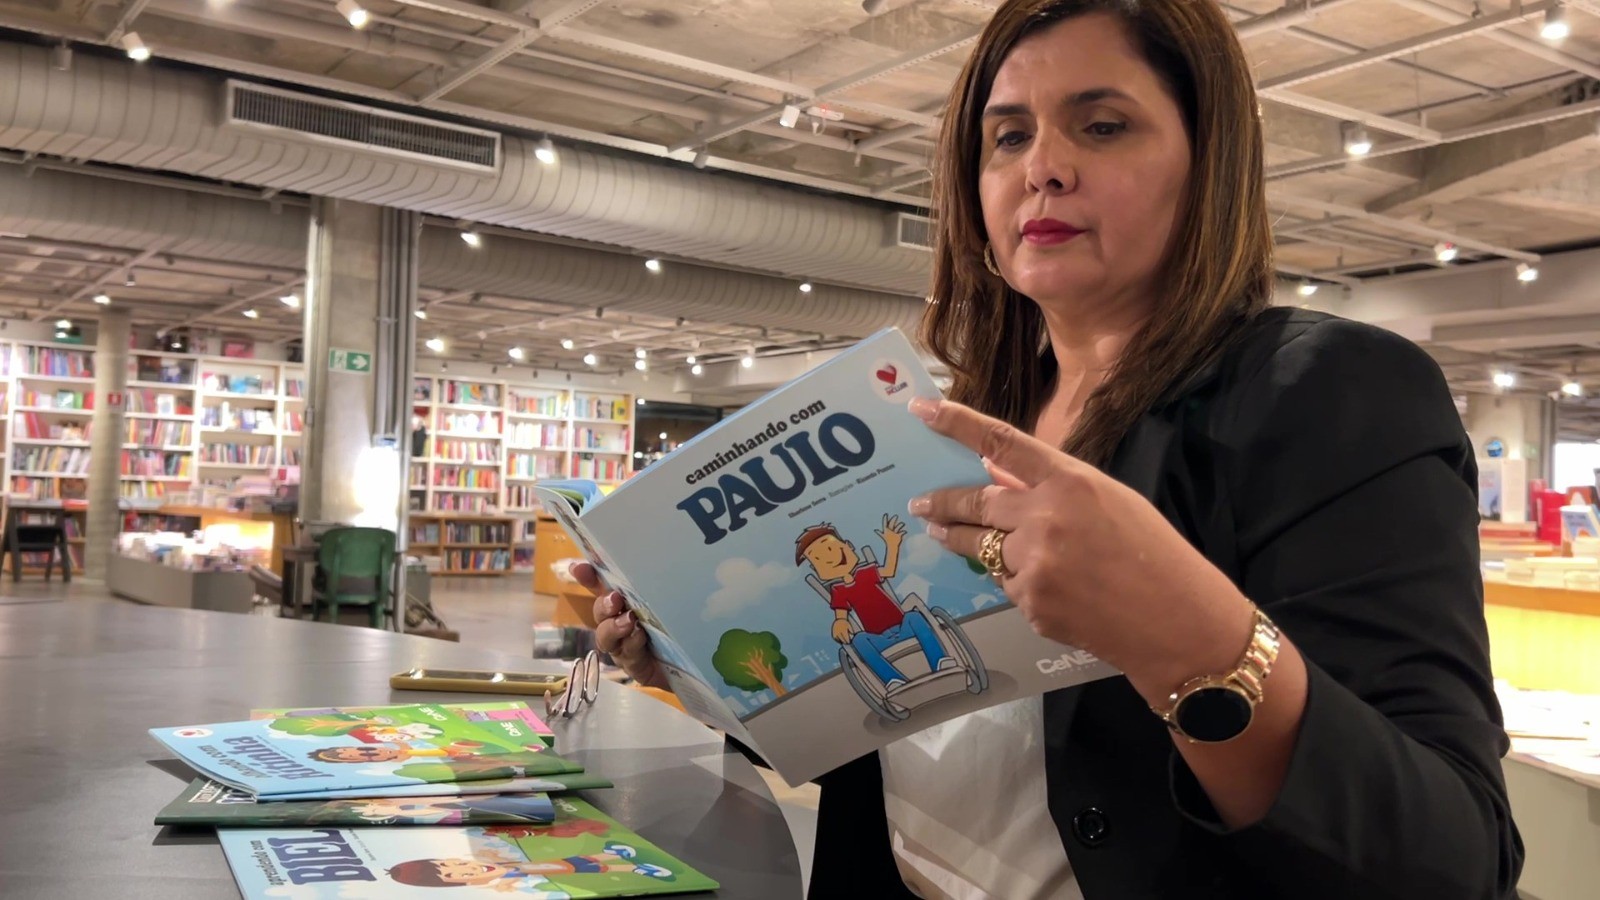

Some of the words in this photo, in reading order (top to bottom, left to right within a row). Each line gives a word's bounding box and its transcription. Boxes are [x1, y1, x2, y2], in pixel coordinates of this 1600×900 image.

[676, 412, 876, 545] PAULO
[685, 423, 788, 485] caminhando
[789, 400, 827, 425] com
[267, 829, 378, 885] BIEL
